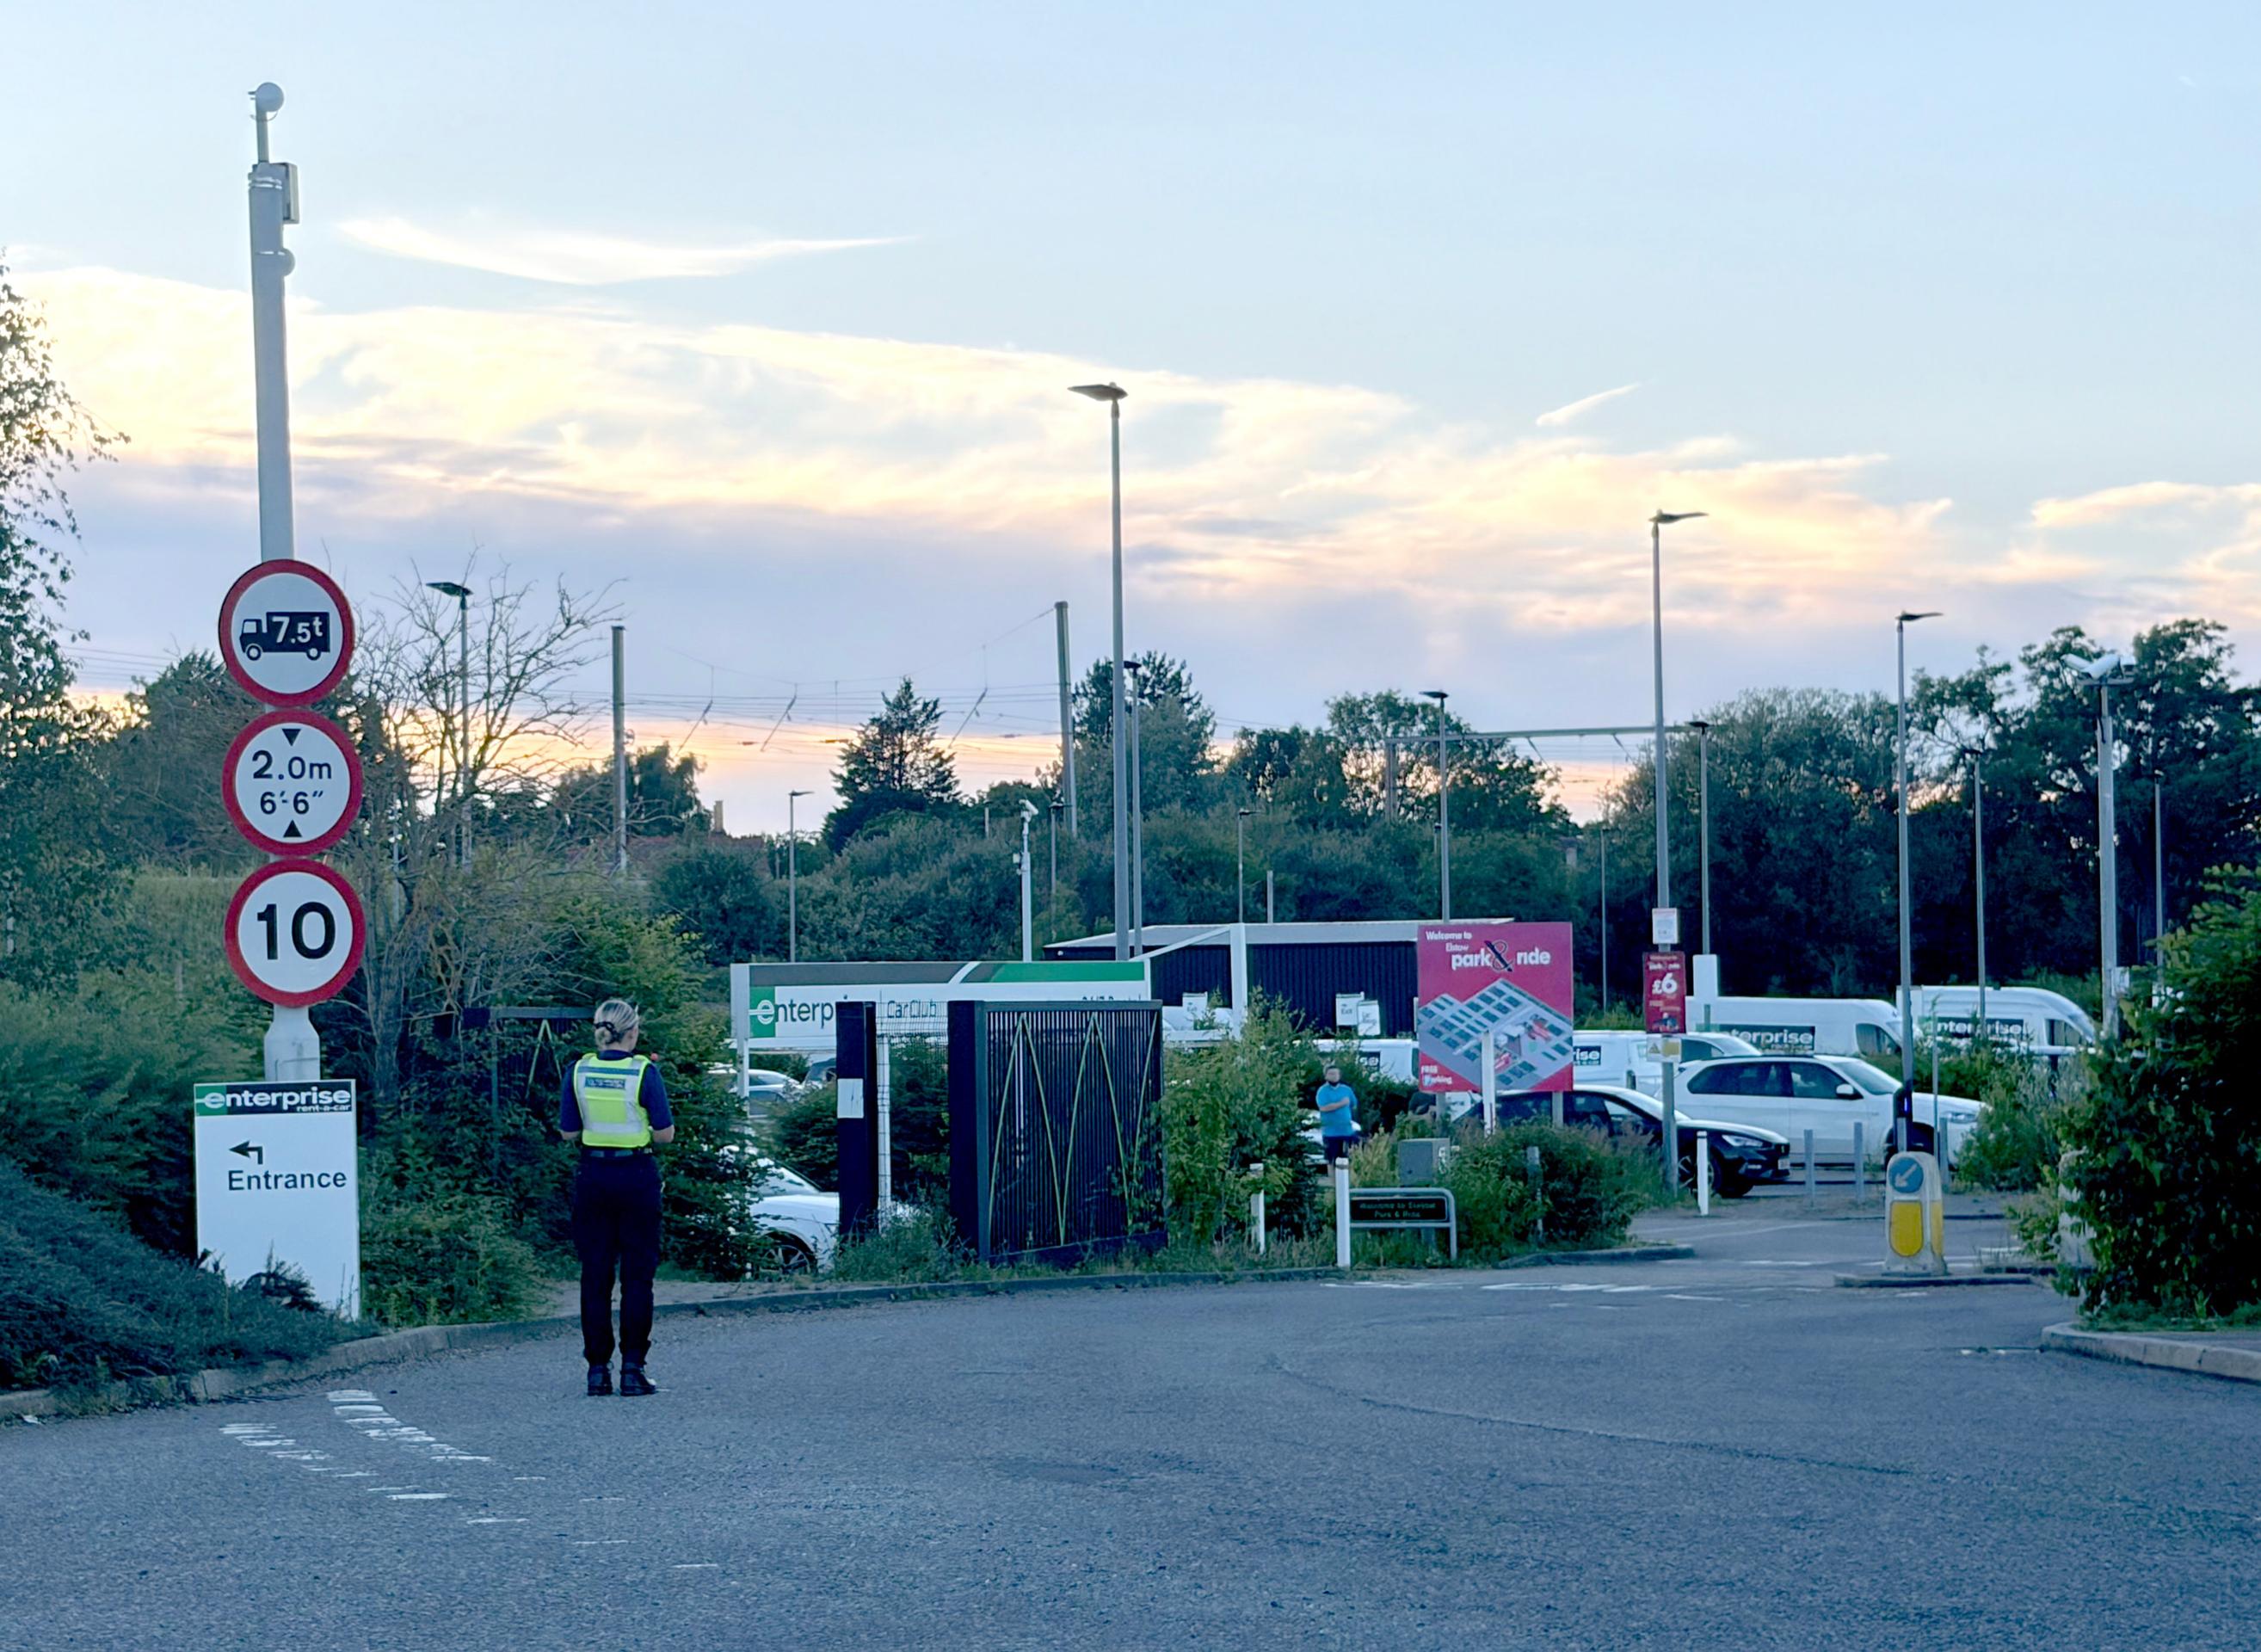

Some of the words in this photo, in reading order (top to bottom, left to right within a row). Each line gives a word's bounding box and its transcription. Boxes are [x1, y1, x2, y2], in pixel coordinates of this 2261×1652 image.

[272, 616, 323, 644] 7.5t
[252, 749, 332, 780] 2.0m
[257, 901, 336, 961] 10
[1451, 947, 1492, 971] park
[1517, 947, 1551, 965] ride
[1652, 972, 1678, 995] £6
[755, 995, 847, 1030] enterp
[203, 1086, 351, 1111] enterprise
[296, 1103, 351, 1113] rent-a-car
[228, 1170, 348, 1191] Entrance
